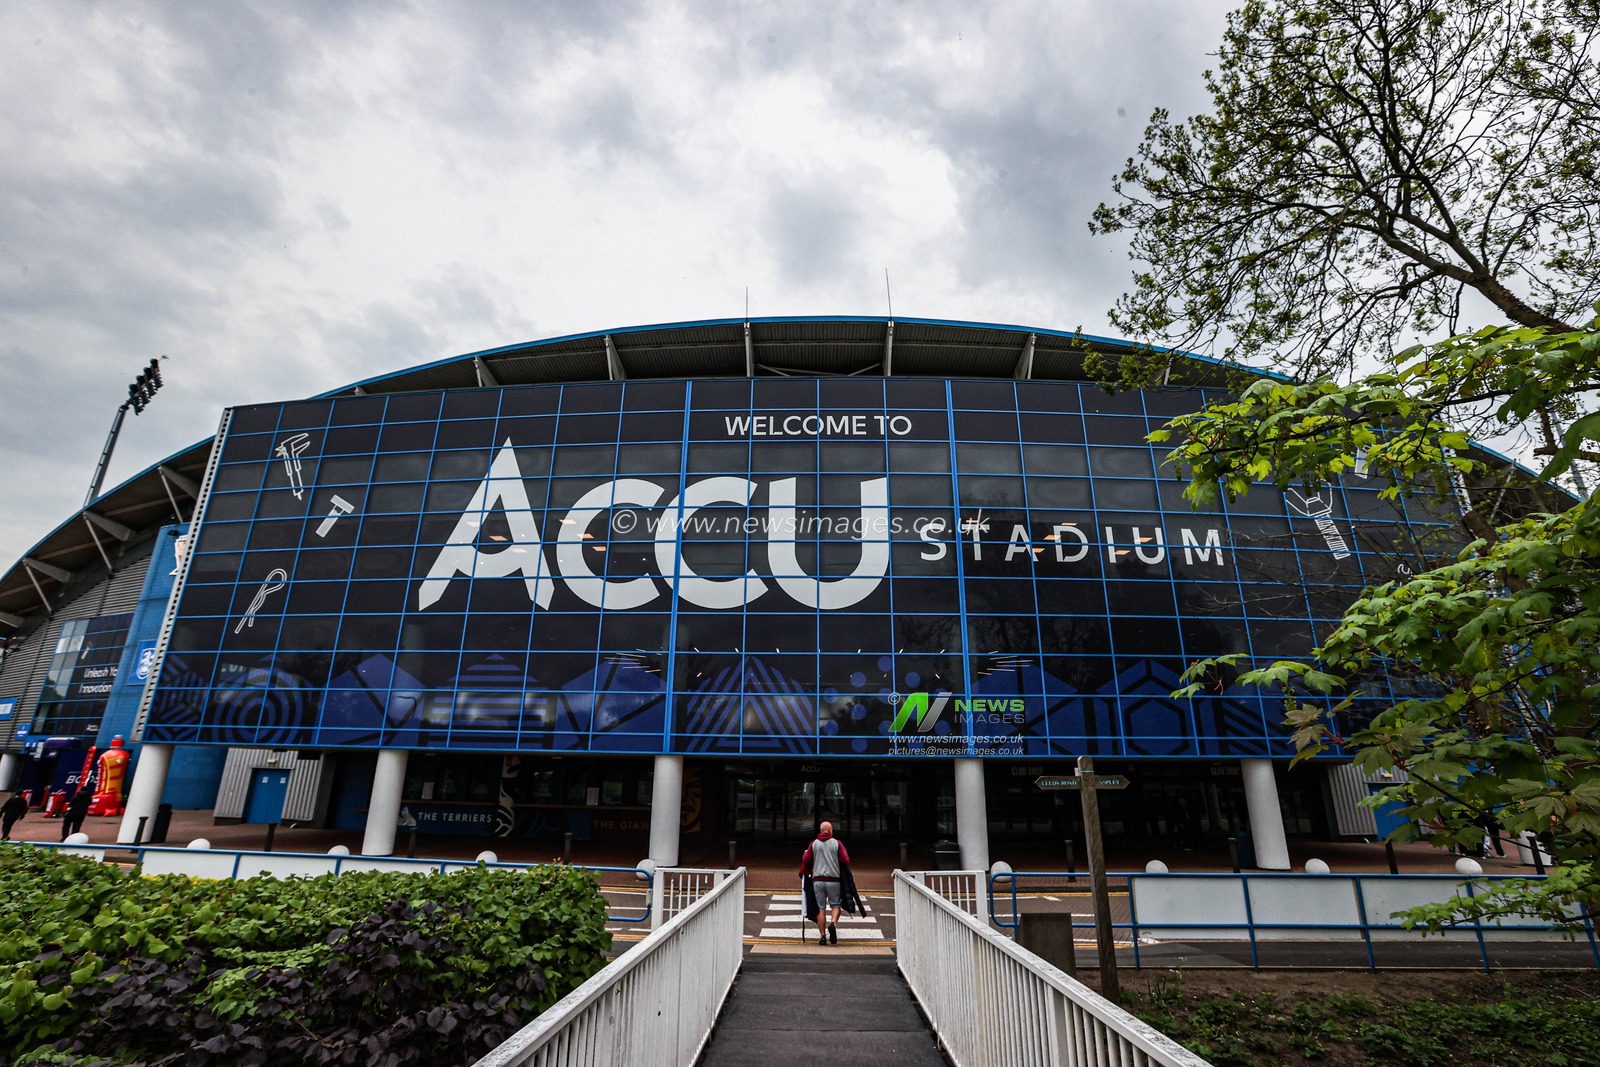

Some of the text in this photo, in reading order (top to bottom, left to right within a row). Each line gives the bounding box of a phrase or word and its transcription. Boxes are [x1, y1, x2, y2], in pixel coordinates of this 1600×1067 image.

[725, 415, 912, 436] WELCOME TO
[418, 436, 890, 611] ACCU
[920, 522, 1225, 566] STADIUM
[84, 666, 119, 678] Unleash Yo
[1011, 766, 1044, 776] CLUB SHOP
[1210, 766, 1225, 776] CLUB
[418, 811, 492, 824] THE TERRIERS
[593, 819, 649, 831] THE GIAN
